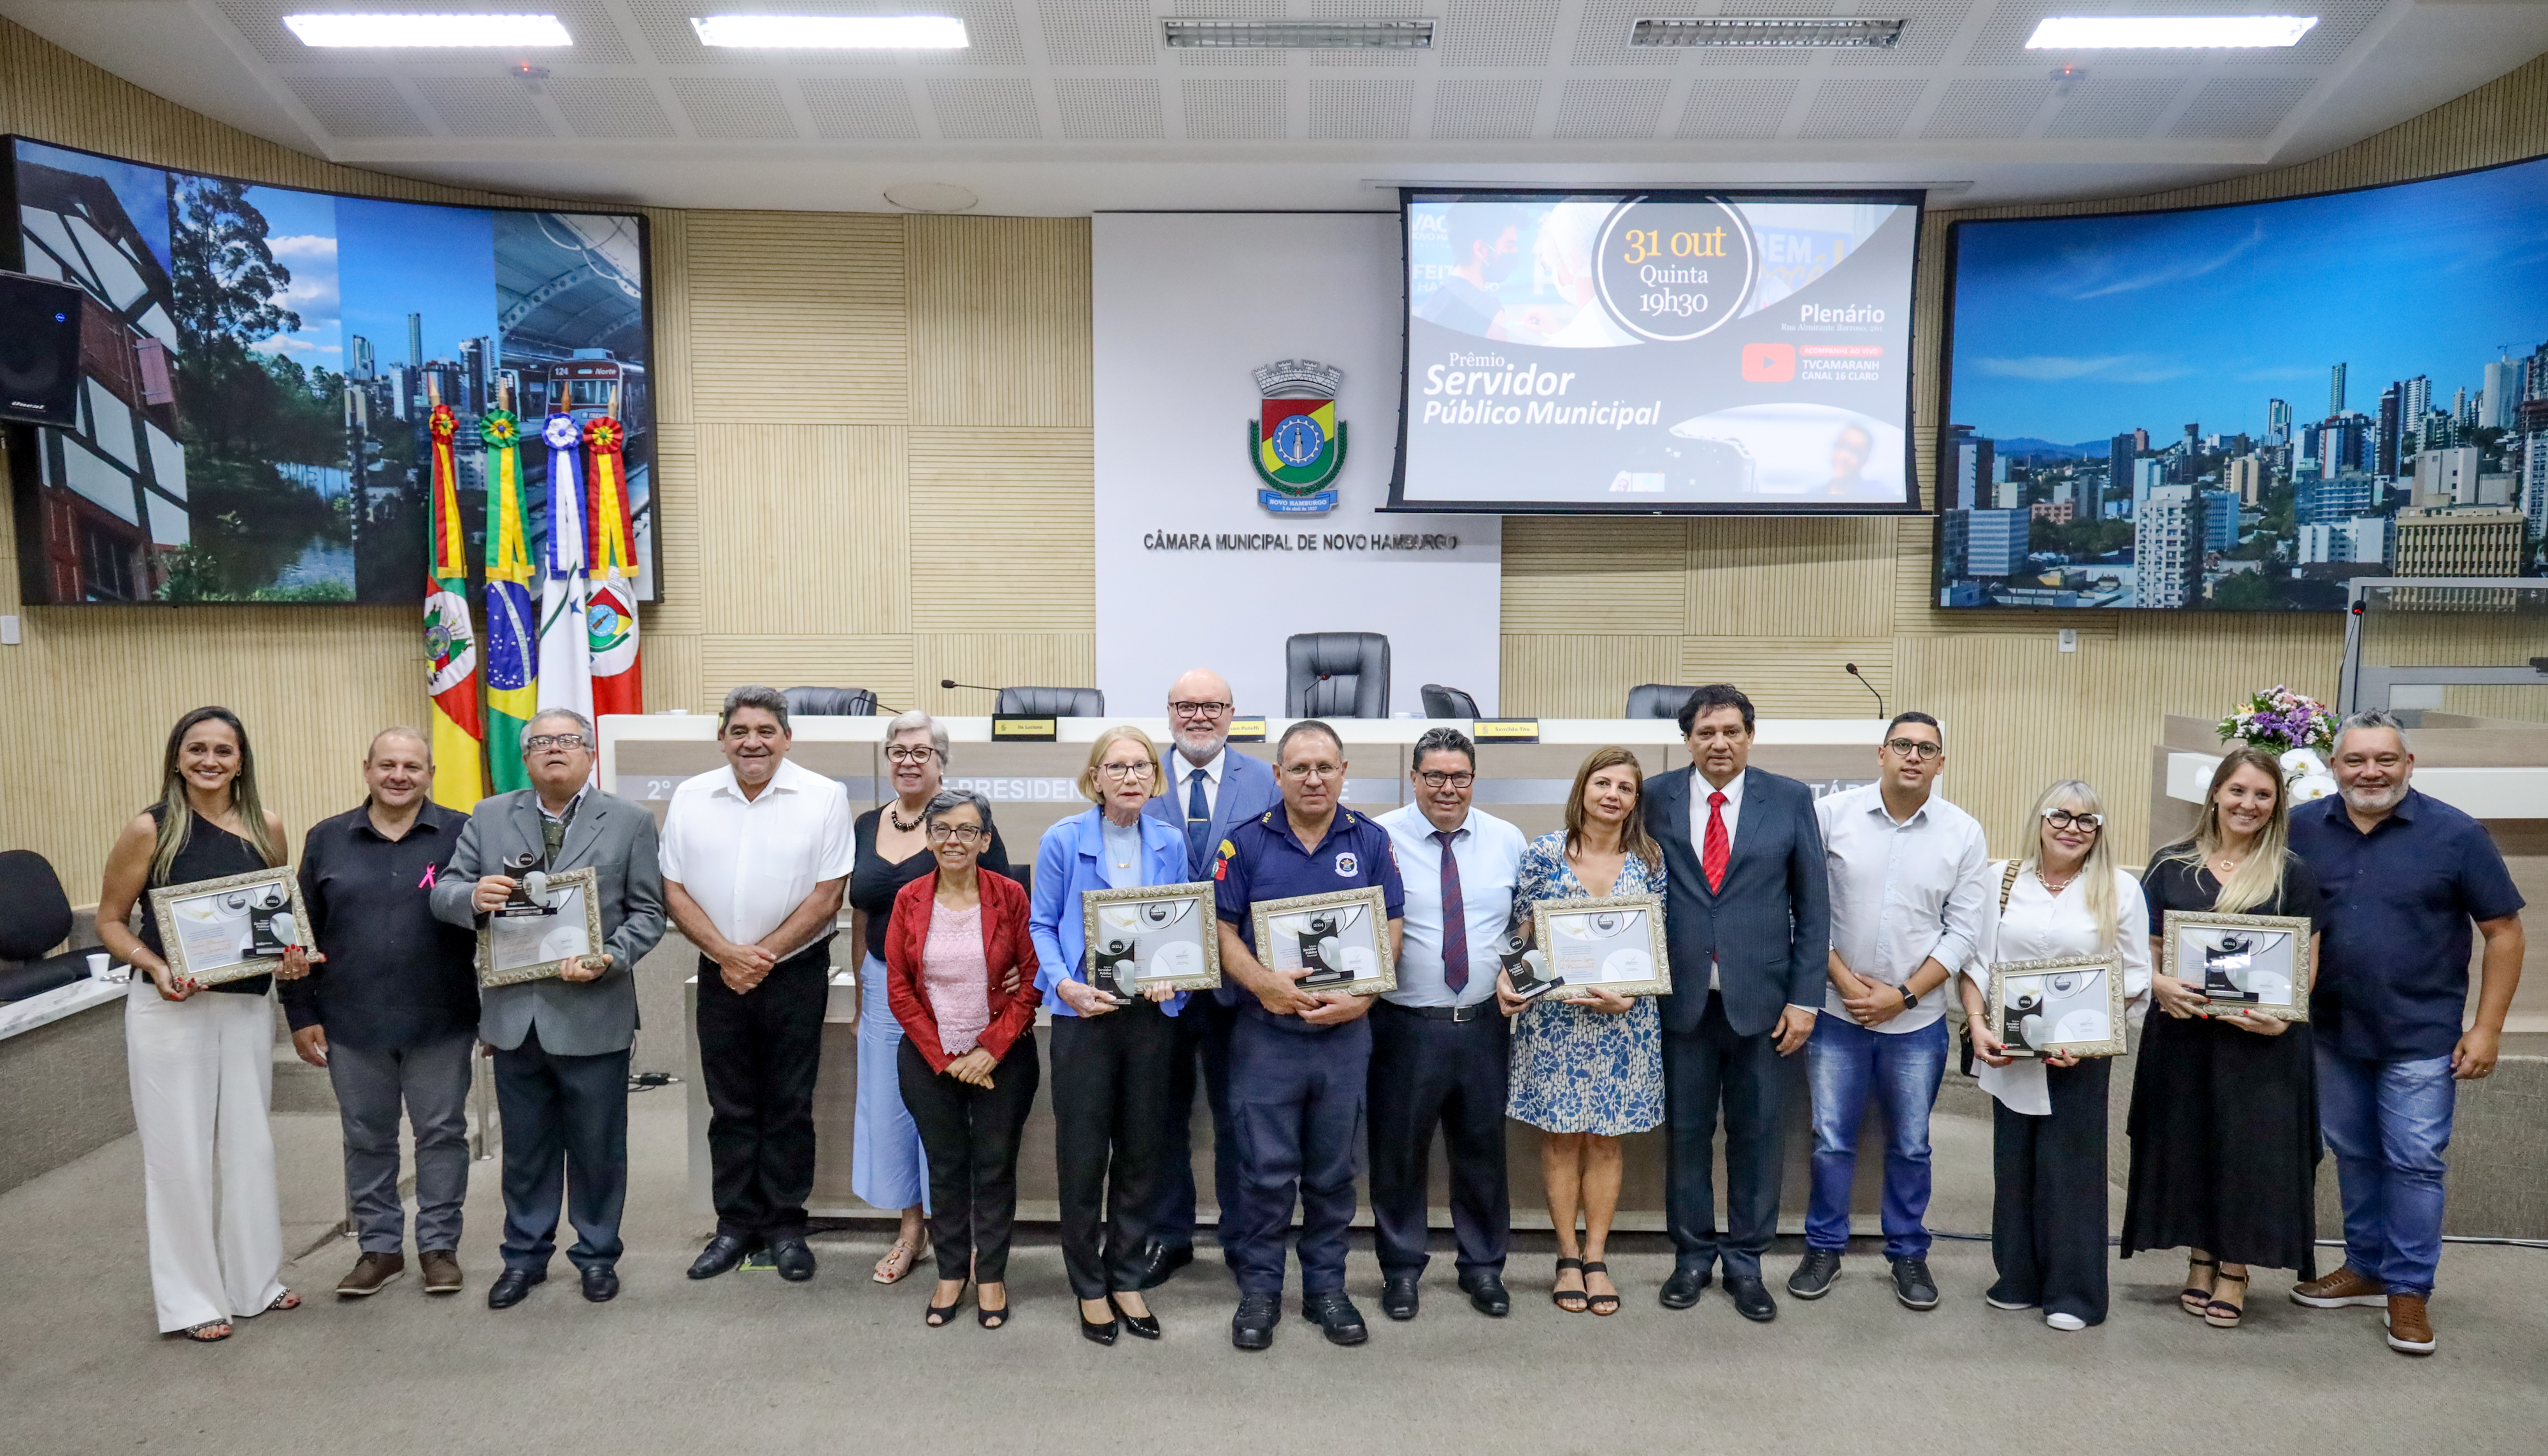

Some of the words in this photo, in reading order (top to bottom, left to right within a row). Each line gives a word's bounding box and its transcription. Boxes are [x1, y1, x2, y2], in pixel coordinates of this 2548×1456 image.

[1624, 230, 1661, 264] 31
[1671, 226, 1727, 257] out
[1640, 264, 1708, 287] Quinta
[1640, 287, 1708, 317] 19h30
[1801, 304, 1885, 323] Plenário
[1449, 352, 1505, 367] Prêmio
[1802, 360, 1880, 370] TVCAMARANH
[555, 368, 569, 376] 124
[1423, 363, 1575, 396] Servidor
[1802, 371, 1833, 380] CANAL
[1835, 372, 1846, 380] 16
[1848, 372, 1879, 380] CLARO
[1423, 399, 1521, 424] Público
[1525, 401, 1661, 431] Municipal
[1143, 529, 1212, 551] CÂMARA
[1215, 534, 1292, 551] MUNICIPAL
[1298, 534, 1317, 551] DE
[1323, 534, 1366, 551] NOVO
[1370, 534, 1458, 551] HAMBURGO
[1262, 811, 1271, 823] GM
[1345, 813, 1356, 824] GM
